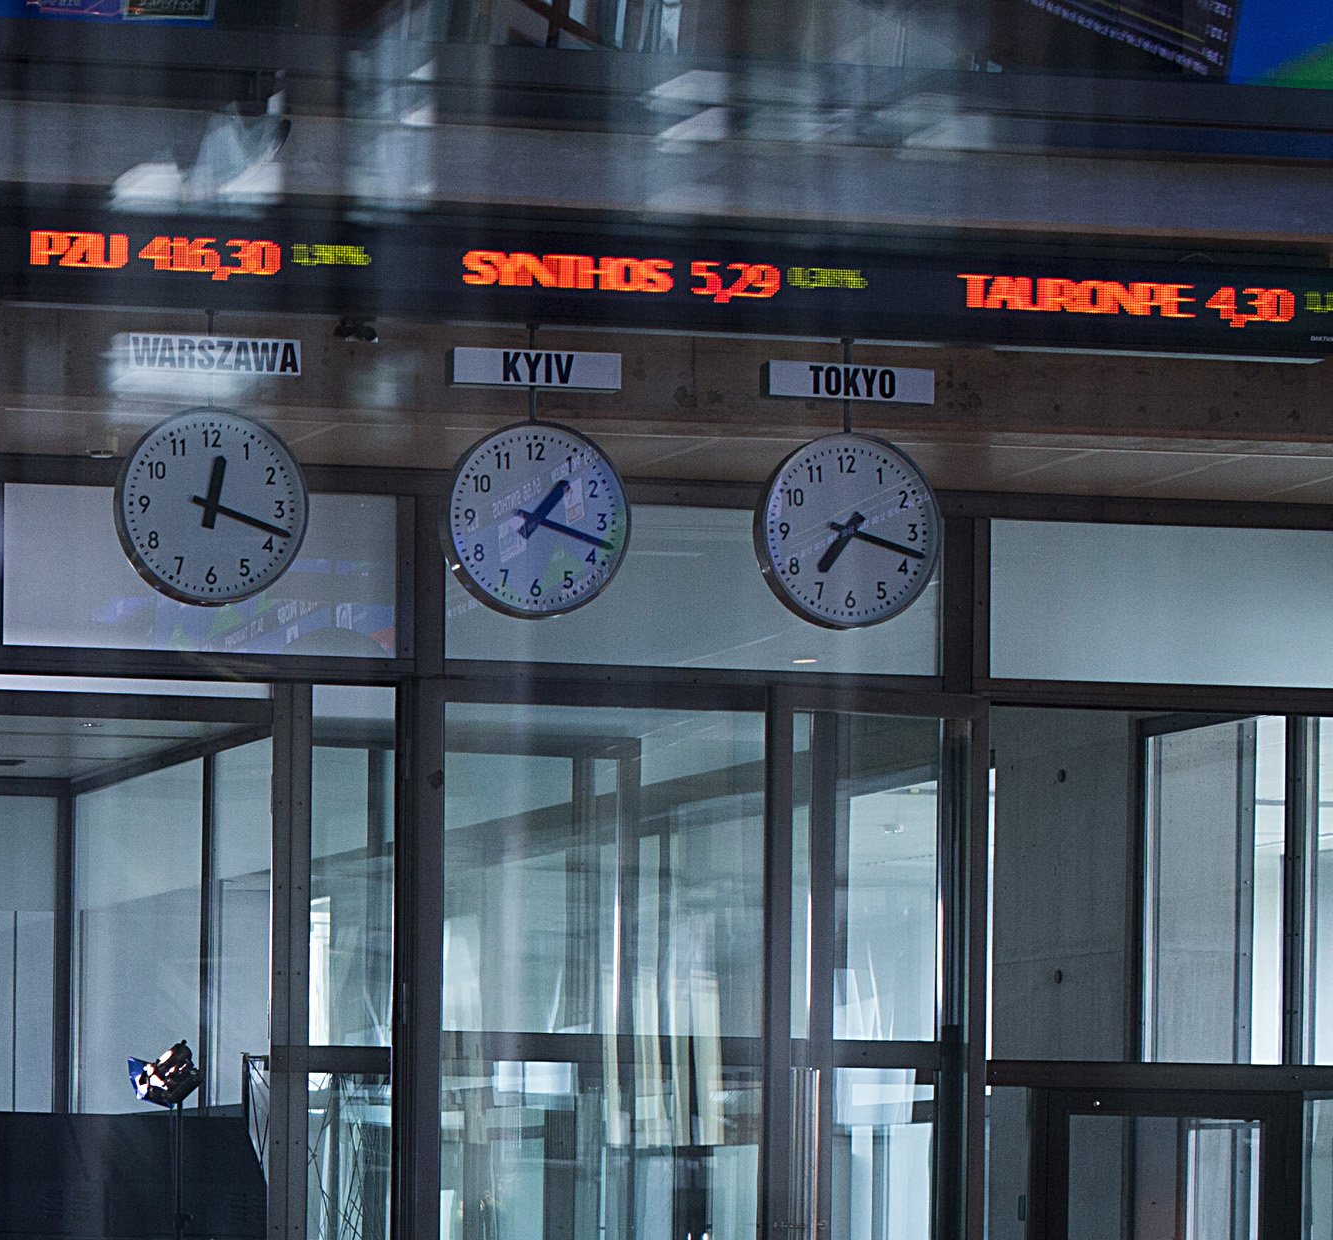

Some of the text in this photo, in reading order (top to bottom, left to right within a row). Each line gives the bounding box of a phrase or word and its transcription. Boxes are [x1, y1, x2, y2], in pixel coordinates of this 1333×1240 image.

[30, 231, 129, 269] PZU
[138, 236, 281, 281] 416,30
[462, 250, 674, 292] SYNTHOS
[690, 261, 781, 303] 5,29
[1205, 286, 1295, 328] 4,30
[132, 336, 300, 375] WARSZAWA
[501, 351, 575, 385] KYIV
[808, 364, 897, 399] TOKYO
[170, 438, 186, 457] 11
[202, 429, 222, 449] 12
[243, 442, 250, 461] 1
[495, 451, 510, 470] 11
[526, 442, 545, 462] 12
[147, 460, 167, 480] 10
[565, 455, 573, 473] 1
[837, 454, 856, 474] 12
[265, 466, 276, 486] 2
[472, 474, 491, 493] 10
[807, 465, 822, 483] 11
[876, 467, 883, 485] 1
[588, 479, 599, 499] 2
[786, 488, 805, 507] 10
[138, 494, 151, 514] 9
[898, 489, 909, 509] 2
[274, 500, 285, 520] 3
[463, 507, 476, 525] 9
[596, 512, 608, 532] 3
[778, 522, 791, 541] 9
[146, 530, 160, 550] 8
[908, 523, 918, 542] 3
[262, 534, 275, 553] 4
[473, 543, 485, 562] 8
[173, 555, 185, 575] 7
[585, 548, 597, 565] 4
[204, 566, 218, 586] 6
[239, 558, 251, 577] 5
[788, 559, 800, 576] 8
[897, 558, 909, 575] 4
[499, 568, 510, 587] 7
[563, 570, 574, 589] 5
[530, 578, 543, 598] 6
[814, 581, 825, 600] 7
[876, 581, 887, 600] 5
[844, 590, 857, 609] 6
